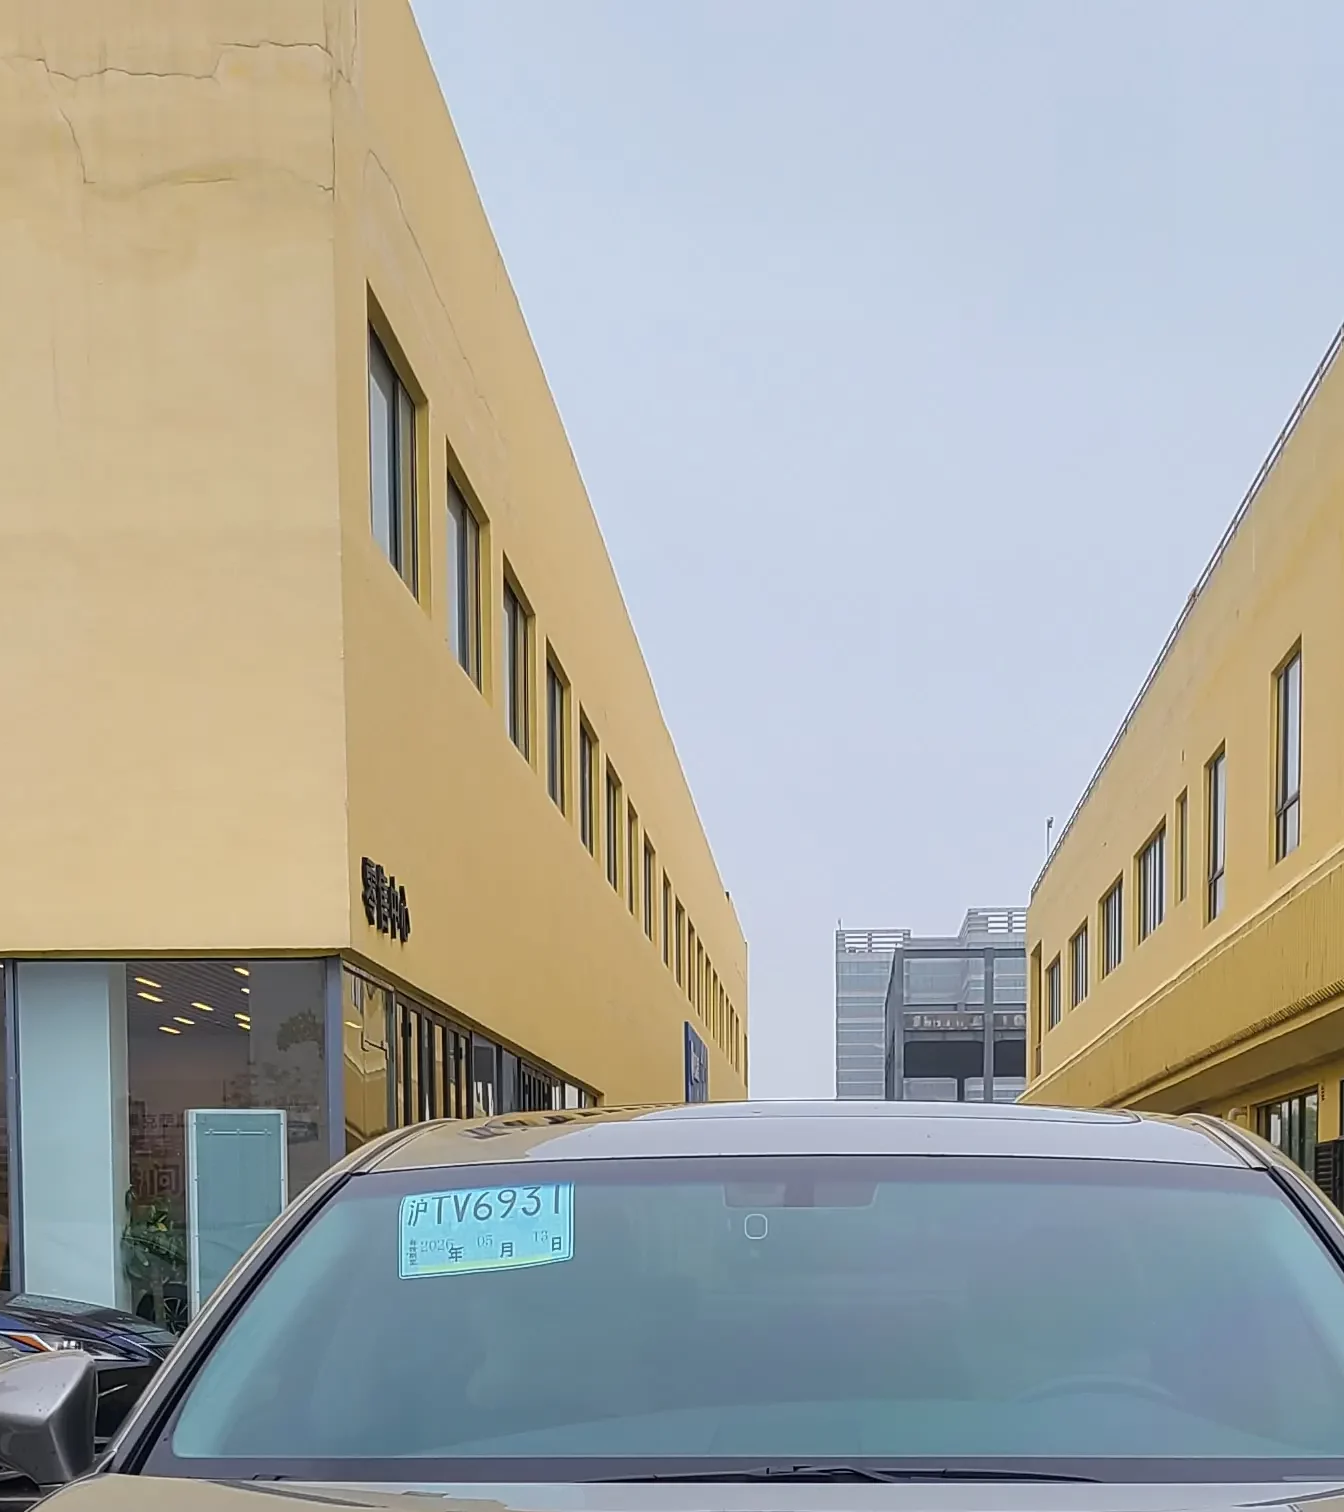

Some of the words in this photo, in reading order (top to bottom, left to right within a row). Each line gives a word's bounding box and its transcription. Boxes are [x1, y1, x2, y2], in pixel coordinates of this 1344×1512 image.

[362, 857, 411, 943] 零售中心
[448, 1246, 464, 1262] 年
[499, 1242, 514, 1259] 月
[551, 1236, 563, 1252] 日
